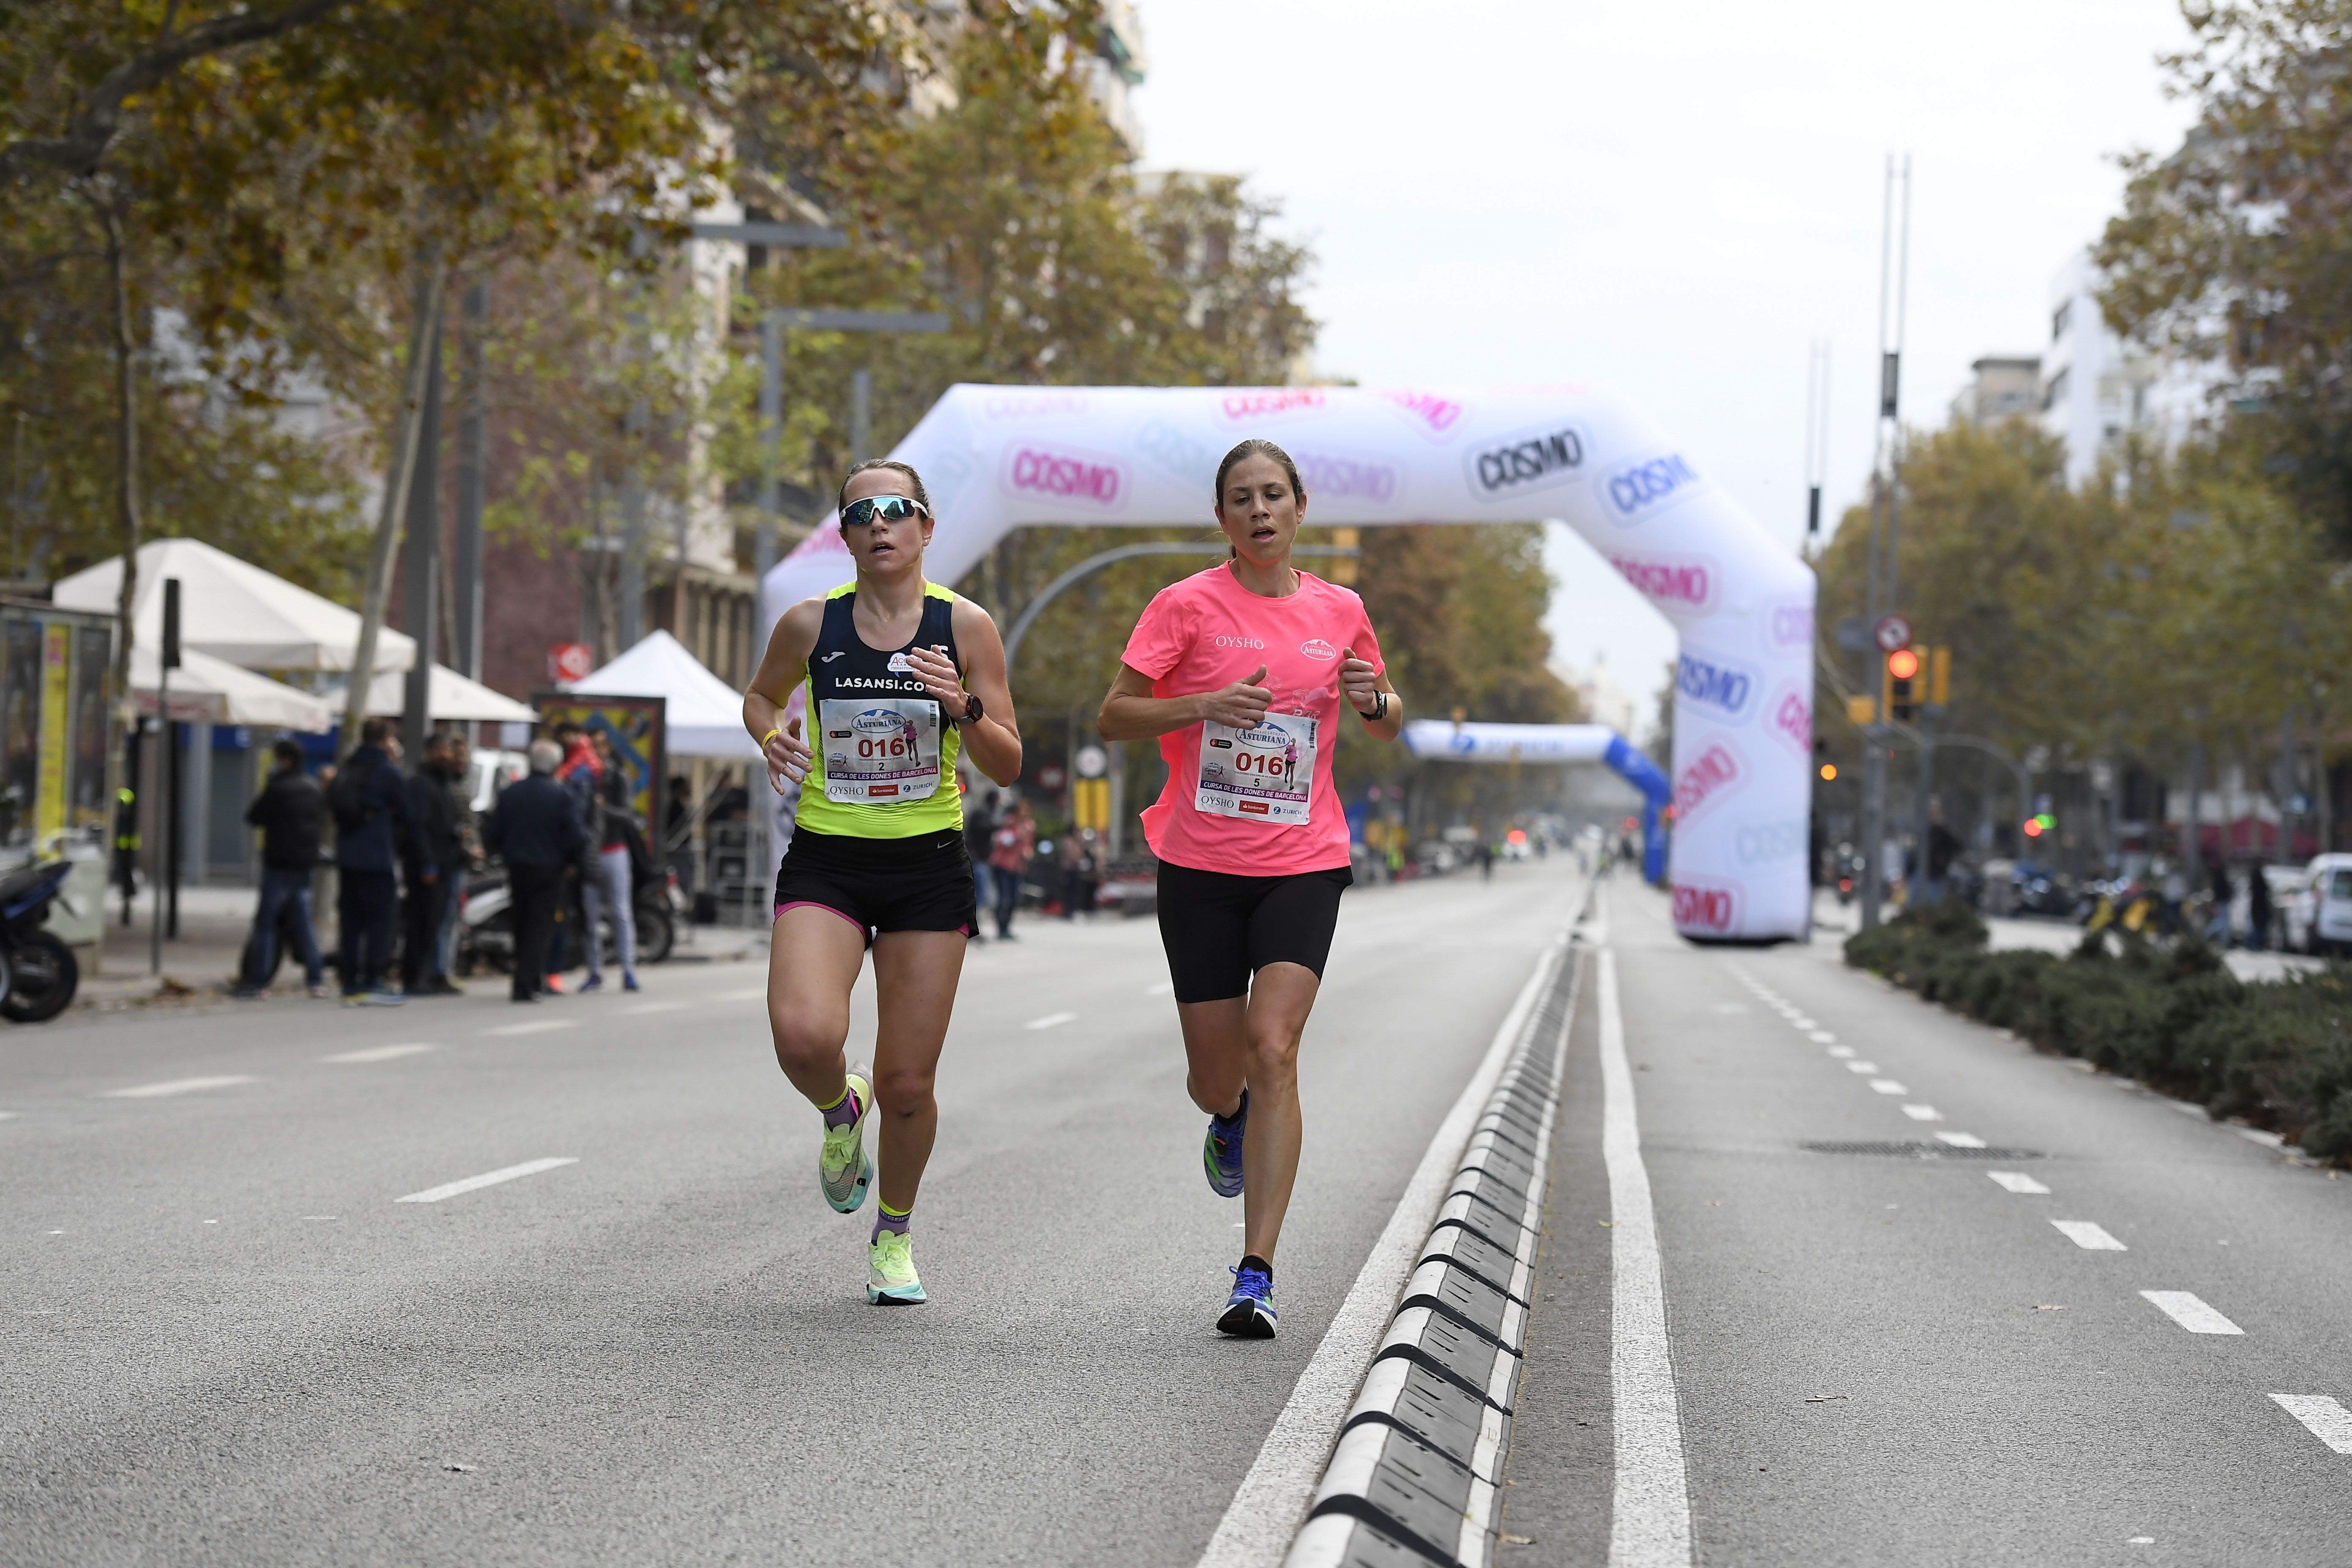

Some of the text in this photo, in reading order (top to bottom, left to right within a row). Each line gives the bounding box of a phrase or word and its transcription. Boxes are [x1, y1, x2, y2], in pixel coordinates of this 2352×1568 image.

[1223, 389, 1326, 418] COSMO
[1478, 429, 1583, 490] COSMO
[1013, 449, 1120, 503] COSMO
[1609, 454, 1698, 513] COSM
[1215, 636, 1264, 650] OYSHO
[835, 677, 928, 692] LASANSI.CO
[856, 719, 902, 728] ASTURIANA
[1239, 728, 1286, 744] ASTURIANA
[858, 738, 905, 757] 016
[879, 762, 885, 771] 2
[1236, 752, 1282, 775] 016
[901, 767, 936, 777] BARCELONA
[1253, 778, 1260, 787] 5
[830, 786, 864, 795] OYSHO
[1203, 781, 1222, 789] CURSA
[1231, 786, 1243, 794] LES
[1244, 788, 1265, 796] DONES
[1274, 792, 1307, 801] BARCELONA
[1201, 795, 1234, 808] OYSHO
